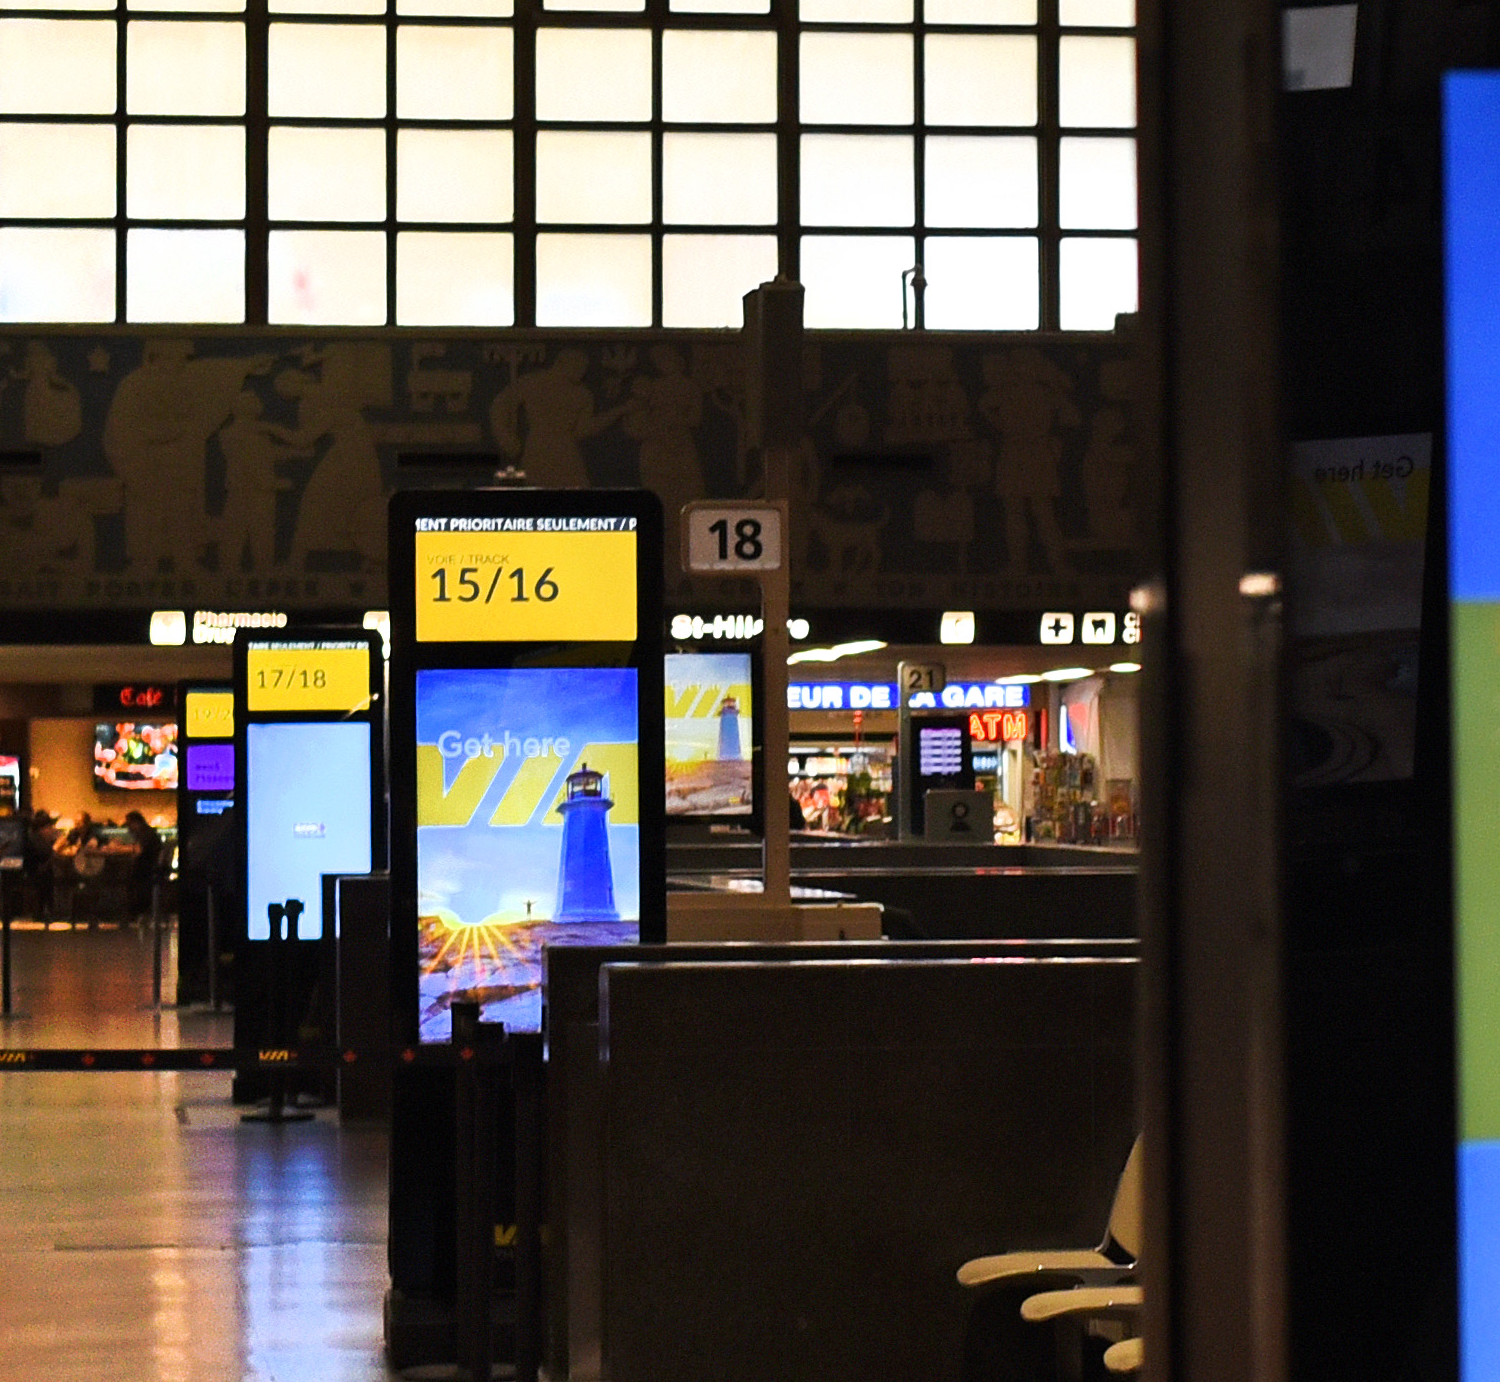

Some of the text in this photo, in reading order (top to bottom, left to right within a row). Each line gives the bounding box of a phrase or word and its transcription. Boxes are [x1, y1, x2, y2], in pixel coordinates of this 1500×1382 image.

[450, 518, 534, 531] PRIORITAIRE
[537, 518, 617, 531] SEULEMENT
[709, 519, 763, 561] 18
[469, 554, 510, 565] TRACK
[430, 566, 560, 605] 15/16
[194, 611, 287, 628] Pharmacie
[257, 668, 327, 691] 17/18
[908, 670, 936, 691] 21
[849, 685, 891, 709] DE
[941, 685, 1025, 709] GARE
[969, 712, 1029, 742] ATM
[437, 730, 571, 758] Get here
[258, 1049, 289, 1062] VIA
